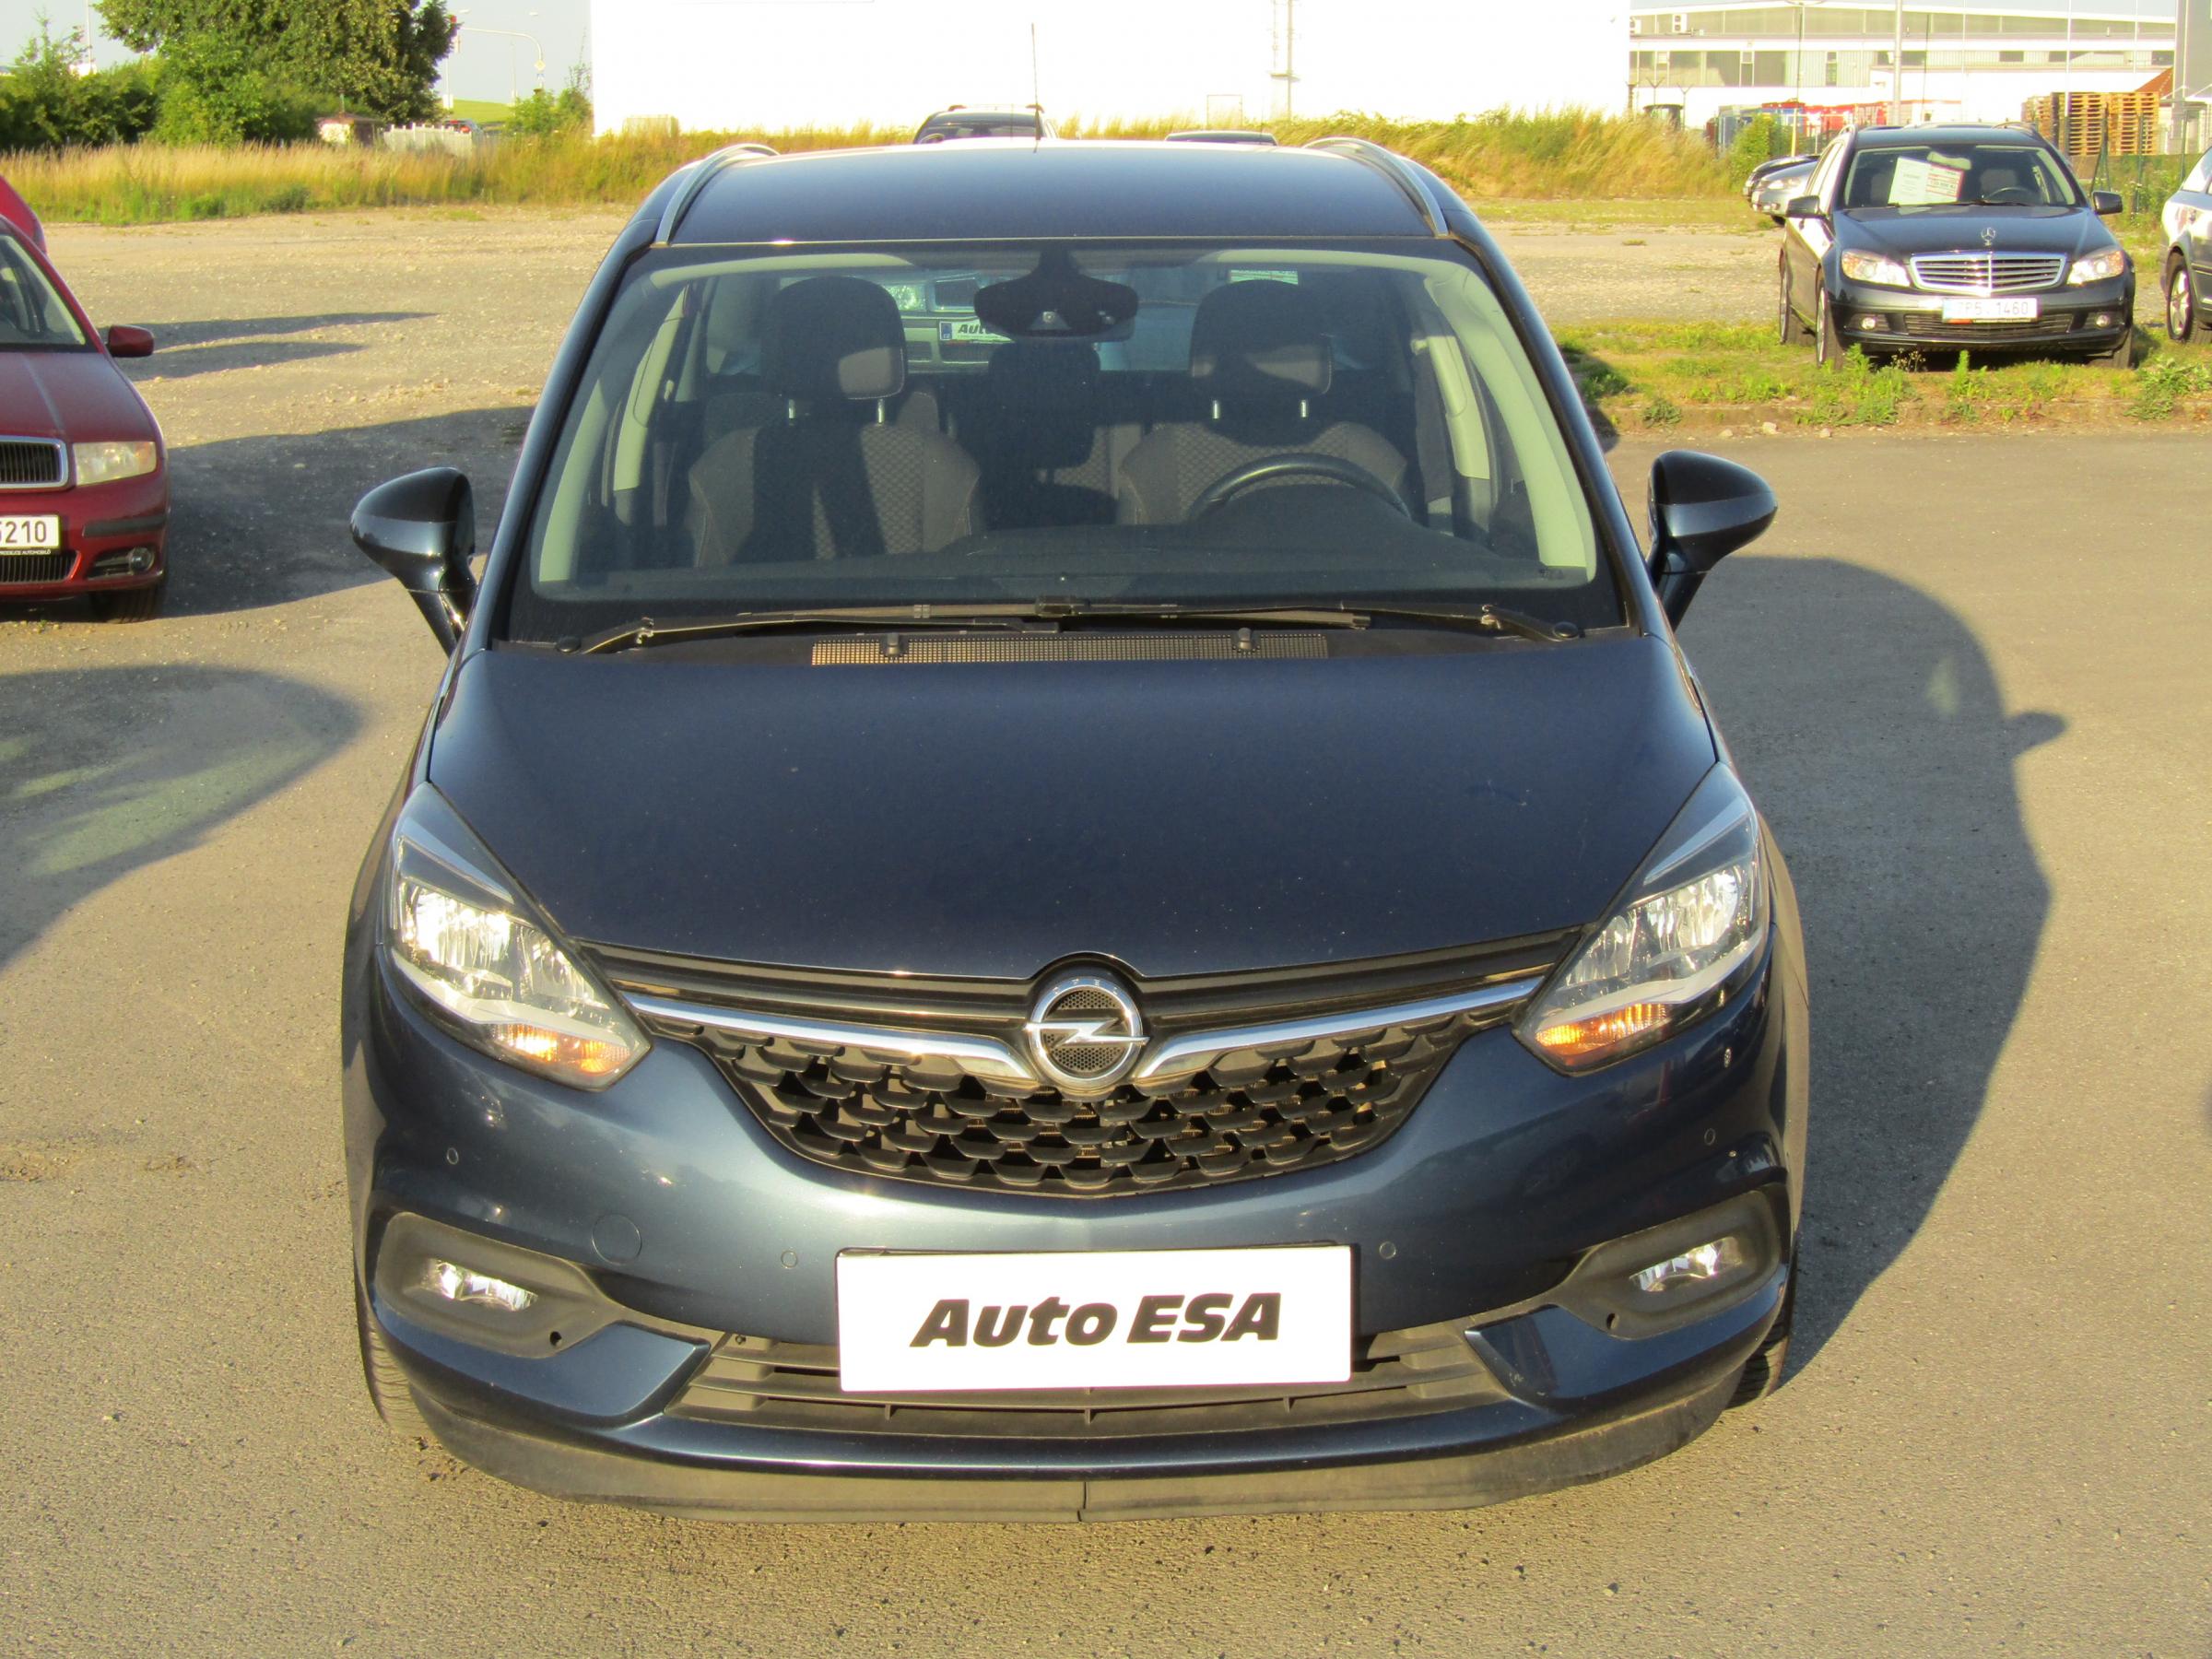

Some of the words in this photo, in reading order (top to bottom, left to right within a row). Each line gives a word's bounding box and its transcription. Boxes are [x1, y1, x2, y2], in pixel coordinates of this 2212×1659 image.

[0, 520, 47, 544] 210
[910, 1296, 1118, 1347] Auto
[1126, 1292, 1281, 1344] ESA
